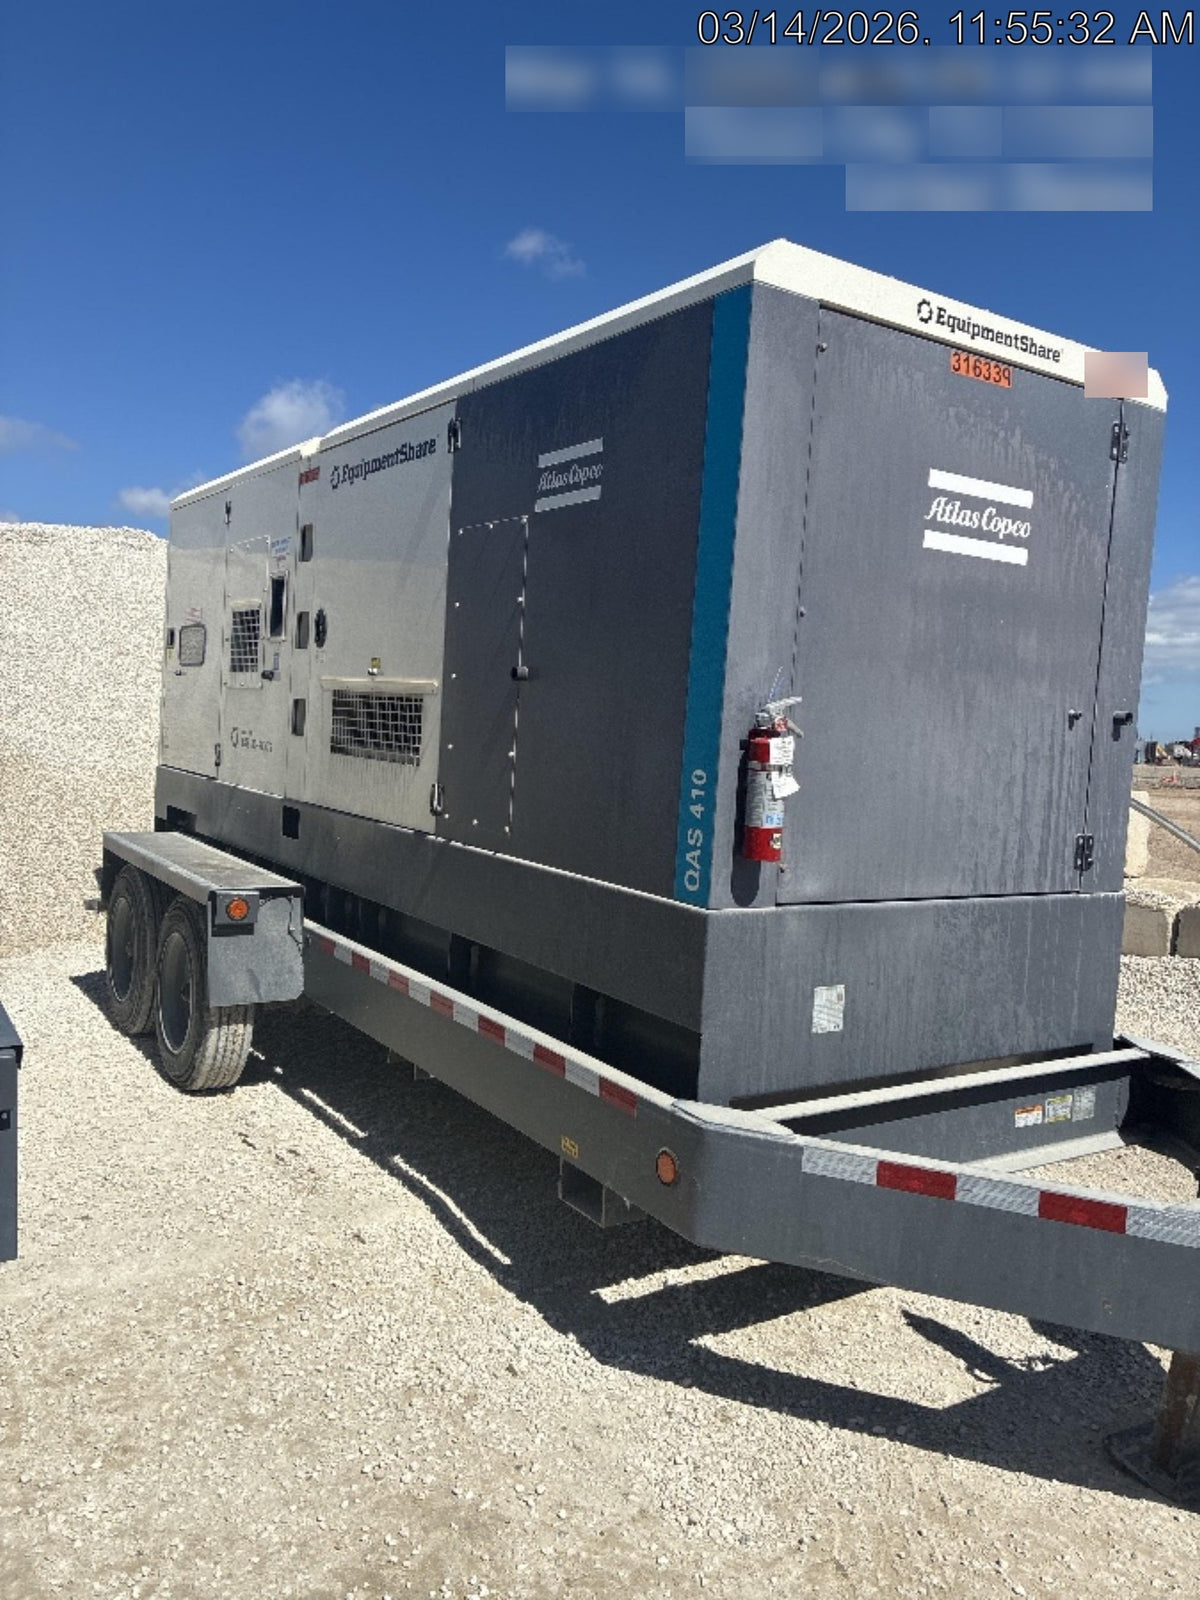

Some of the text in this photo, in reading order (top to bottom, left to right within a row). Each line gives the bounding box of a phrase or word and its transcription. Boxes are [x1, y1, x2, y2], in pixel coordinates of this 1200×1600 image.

[936, 306, 1061, 362] EquipmentShare
[952, 351, 1011, 386] 316339
[341, 438, 436, 485] EquipmentShare
[537, 464, 603, 493] Atlas Copco
[924, 496, 1031, 539] Atlas Copco
[684, 769, 707, 891] QAS 410
